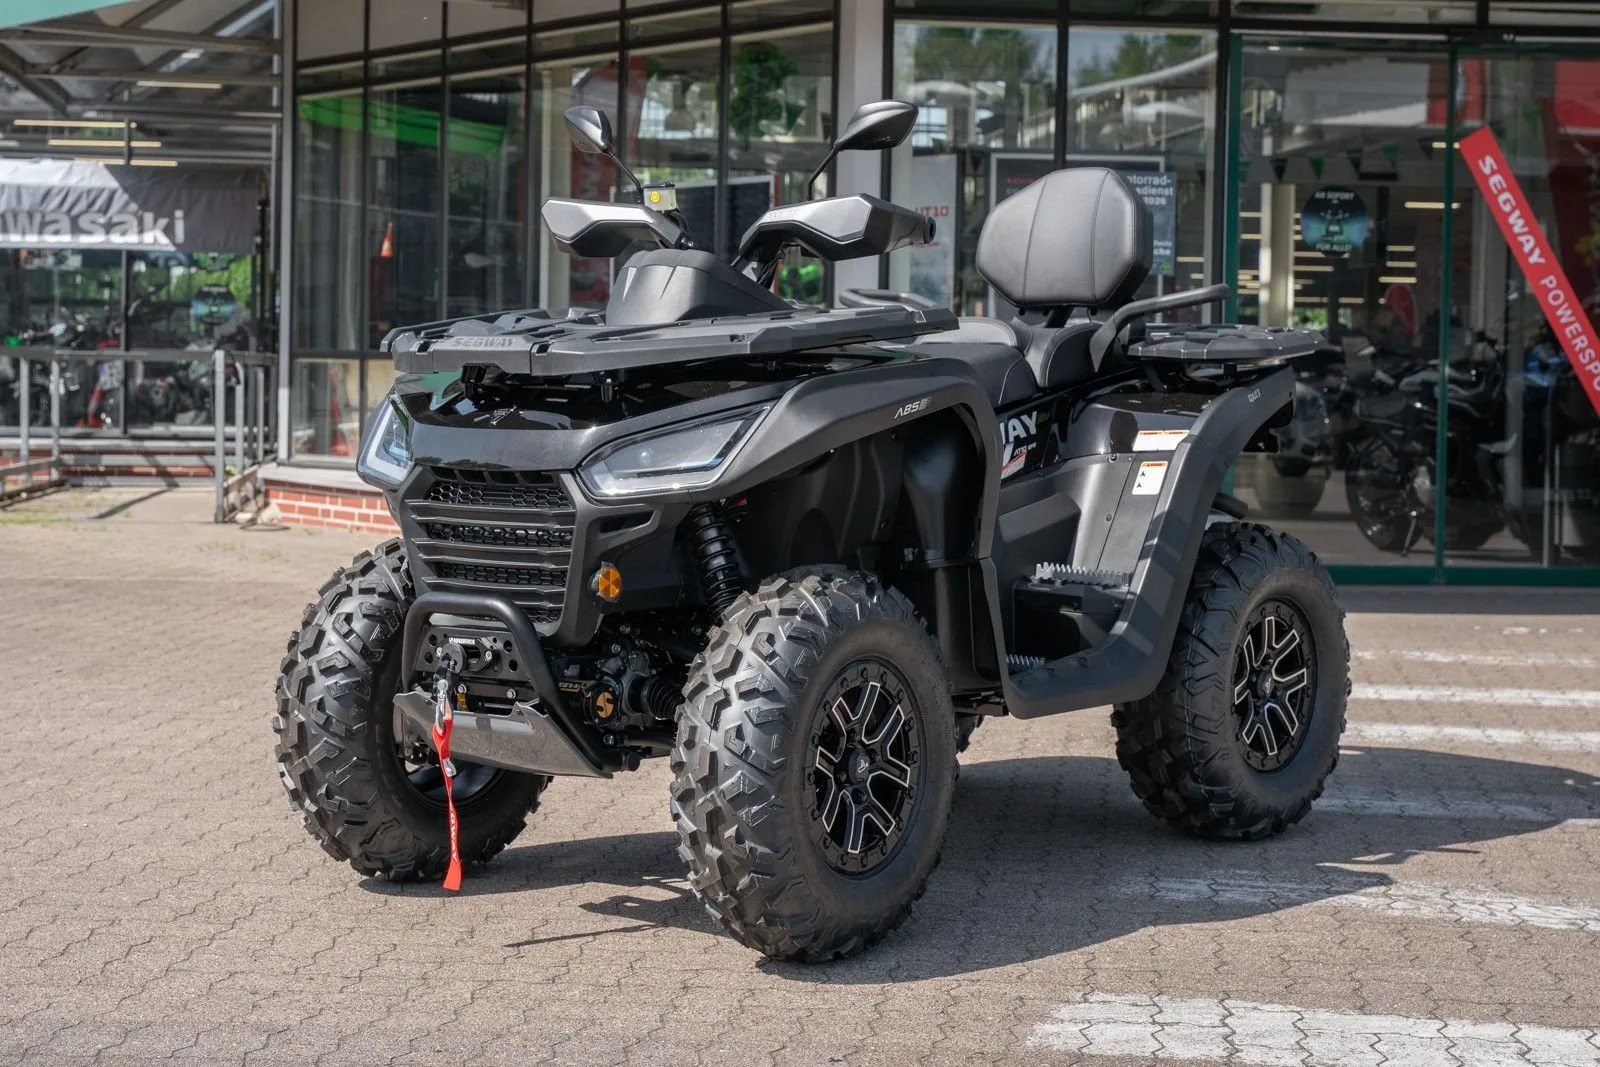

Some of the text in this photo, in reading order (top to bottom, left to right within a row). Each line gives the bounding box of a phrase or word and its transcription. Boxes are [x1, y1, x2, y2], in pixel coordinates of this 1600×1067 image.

[1478, 154, 1546, 265] SEGWAY
[0, 209, 185, 244] wasaki
[452, 336, 517, 348] SEGWAY
[894, 400, 921, 419] ABS
